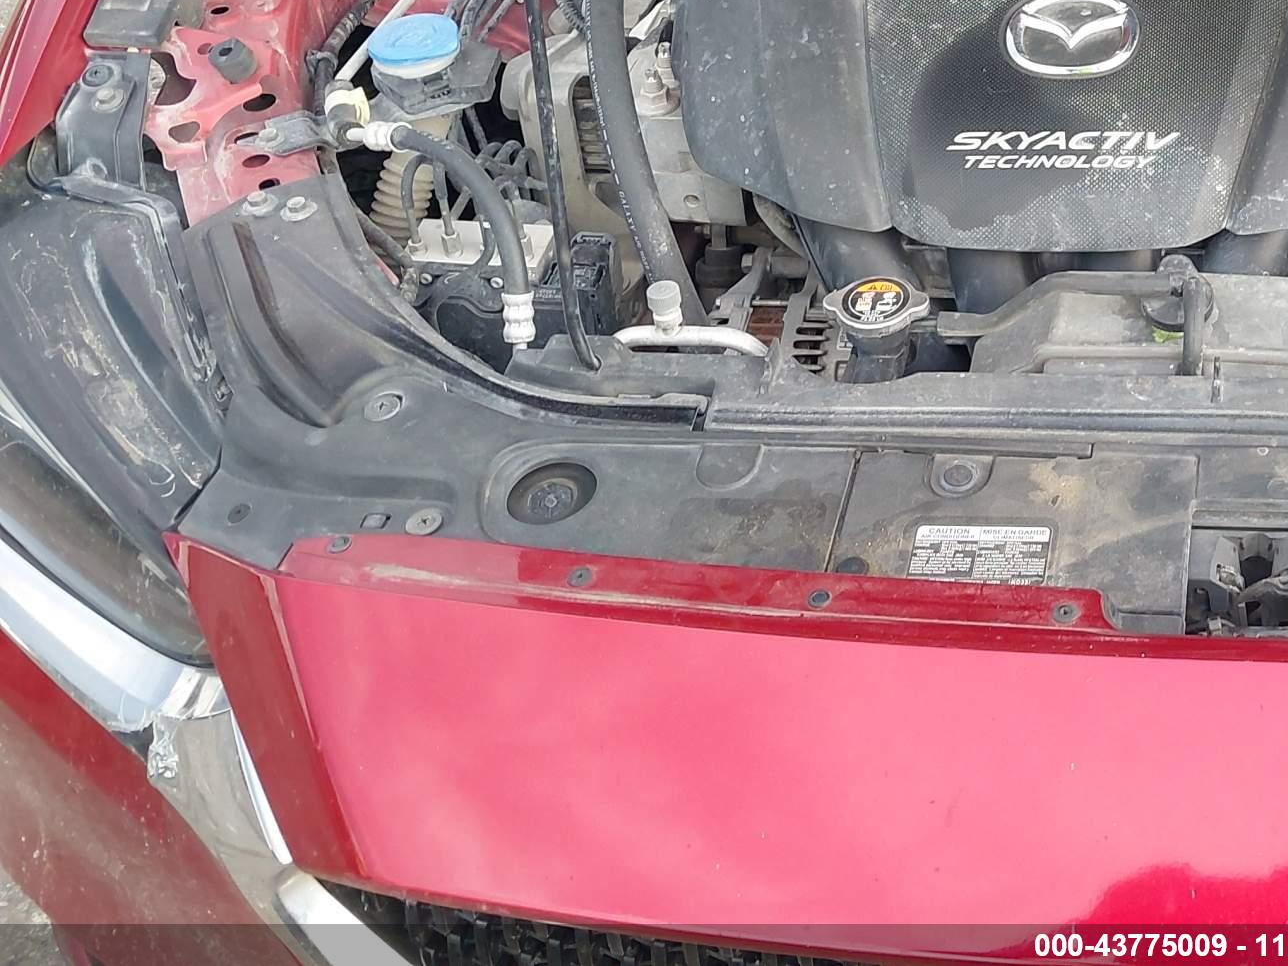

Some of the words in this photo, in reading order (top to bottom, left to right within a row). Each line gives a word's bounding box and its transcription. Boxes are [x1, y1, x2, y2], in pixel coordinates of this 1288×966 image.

[946, 131, 1181, 151] SKYACTIV
[964, 154, 1158, 169] TECHNOLOGY
[929, 527, 970, 535] CAUTION
